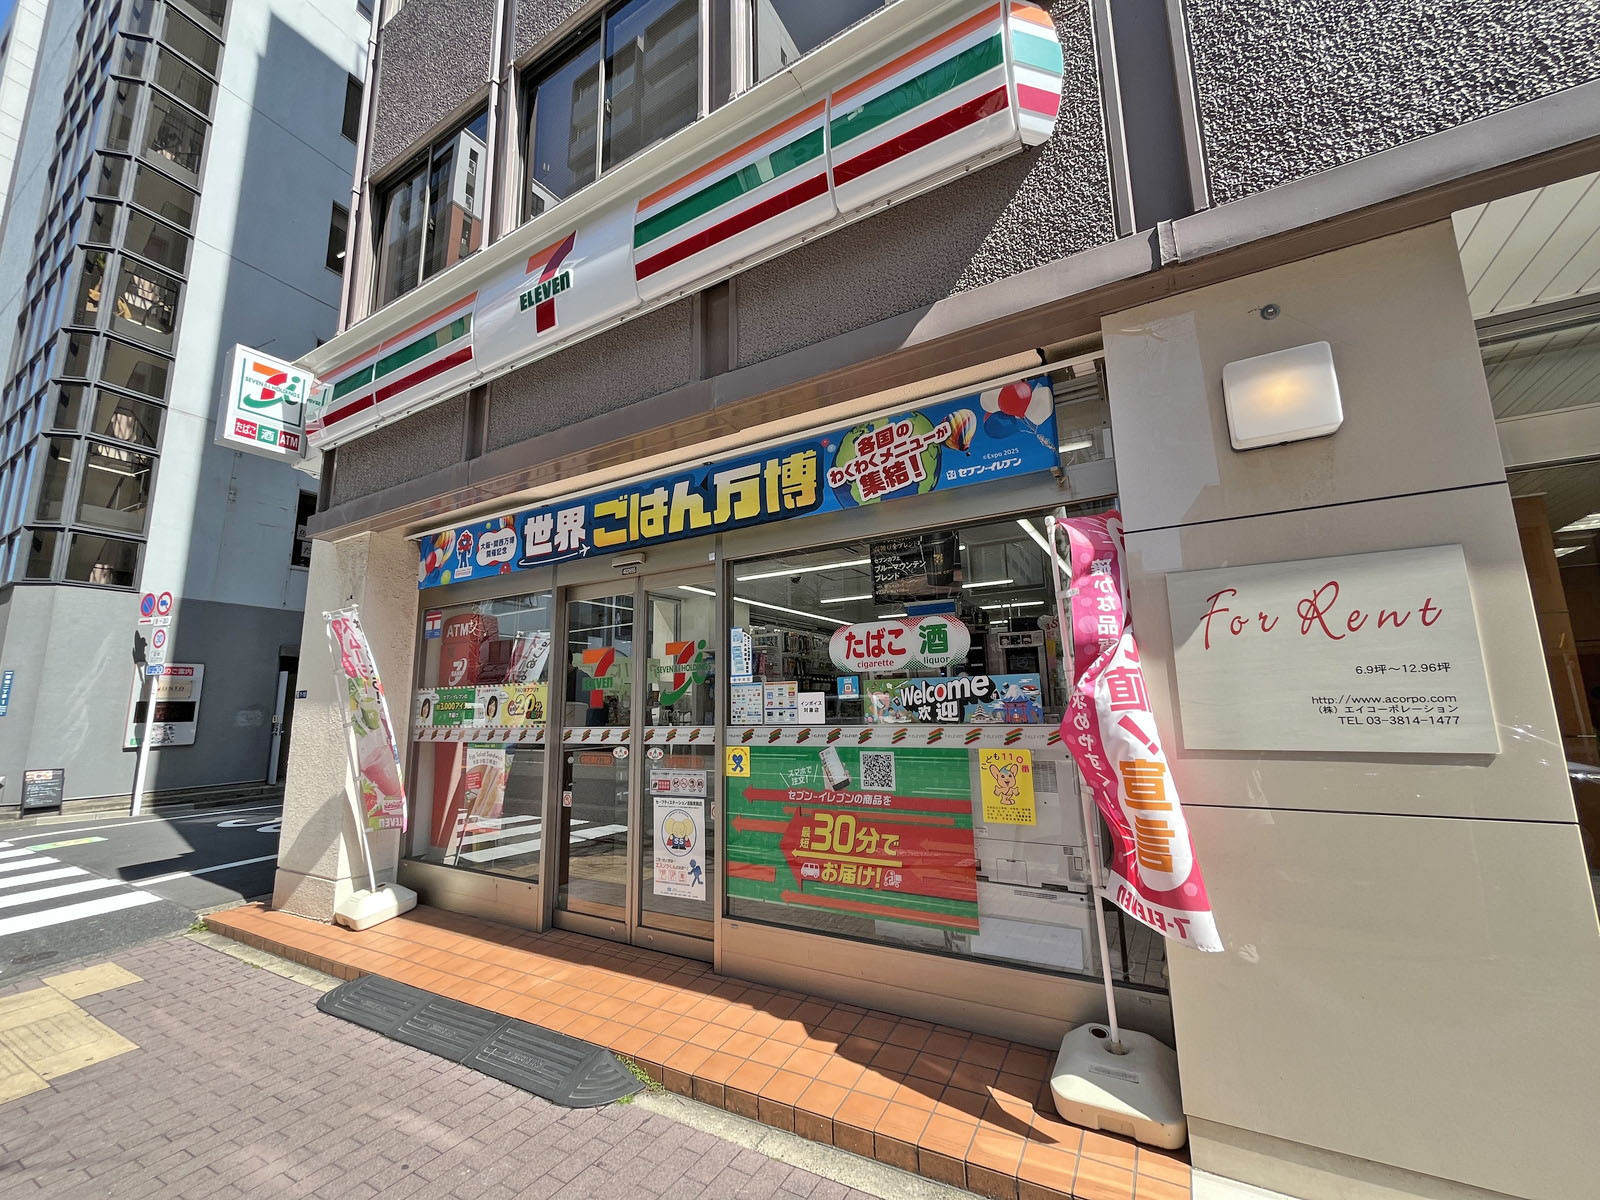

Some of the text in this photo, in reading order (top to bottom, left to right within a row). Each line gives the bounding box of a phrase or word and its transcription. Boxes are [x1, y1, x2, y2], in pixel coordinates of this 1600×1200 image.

[245, 376, 264, 387] SEVEN
[235, 421, 256, 437] たばこ
[261, 429, 275, 442] 酒
[280, 434, 298, 449] ATM
[857, 422, 910, 456] 各国の
[830, 424, 948, 484] わくわくメニューが
[1004, 448, 1019, 456] 2025
[859, 454, 923, 498] 集結!
[875, 560, 926, 573] ブルーマウンテン
[875, 572, 900, 582] ブレンド
[1200, 580, 1442, 650] For Rent
[446, 622, 470, 638] ATM
[845, 627, 906, 659] たばこ
[919, 623, 949, 654] 酒
[857, 658, 895, 668] cigarette
[923, 656, 951, 665] liquor
[657, 664, 673, 674] SEVEN
[900, 675, 990, 707] Welcome
[1311, 695, 1457, 705] http://www.acorpo.com
[918, 700, 959, 722] 欢迎
[1338, 715, 1460, 725] TEL 03-3814-1477
[788, 766, 812, 777] スマホで
[799, 826, 810, 849] 最短
[821, 861, 883, 888] お届け!
